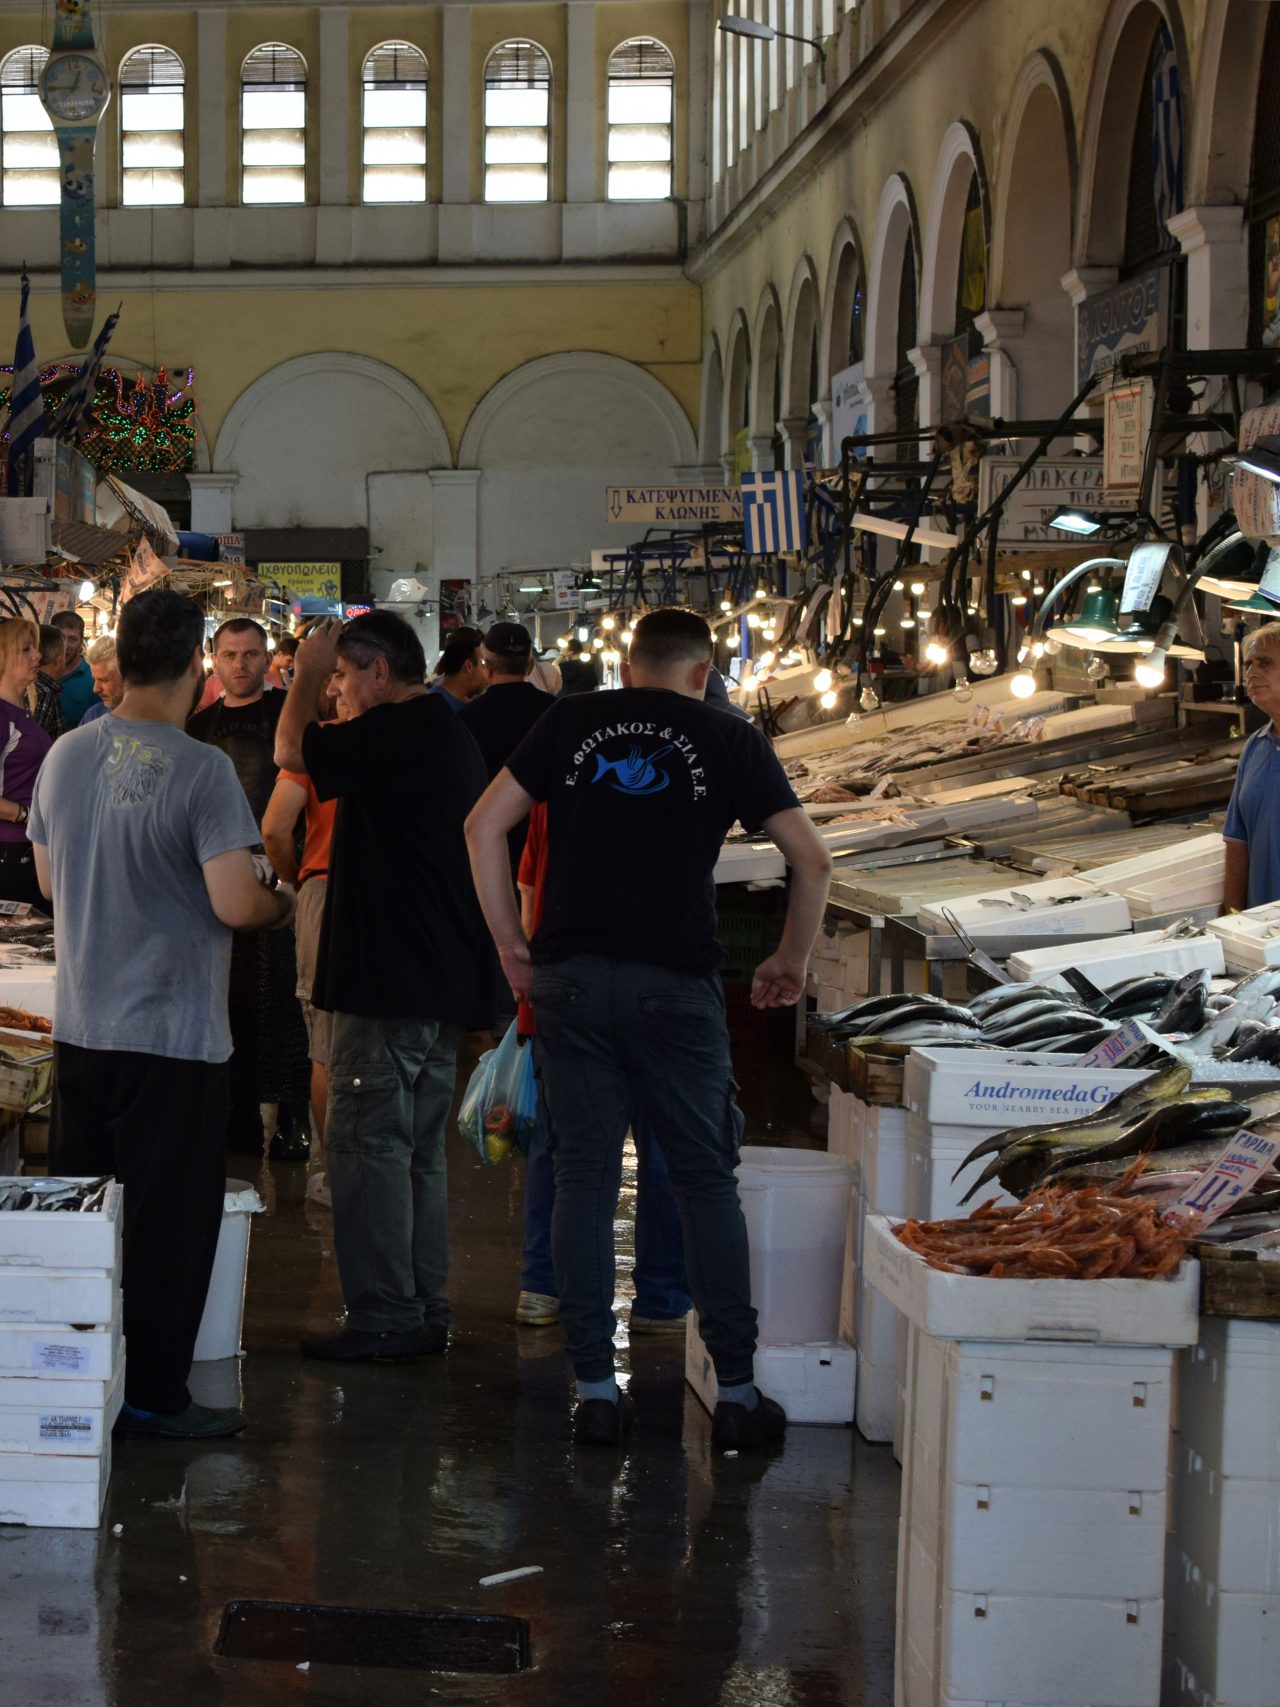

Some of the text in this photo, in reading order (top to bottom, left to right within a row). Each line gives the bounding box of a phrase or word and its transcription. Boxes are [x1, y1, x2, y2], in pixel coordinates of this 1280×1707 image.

[626, 489, 742, 504] ΚΑΤΕΨΥΓΜΕΝΑ
[655, 506, 720, 521] ΚΛΩΝΗΣ
[260, 564, 339, 577] ΙΧΘΥΟΠΩΛΕΙΟ
[573, 722, 657, 765] ΦΩΤΑΚΟΣ
[659, 727, 673, 740] &
[673, 735, 697, 764] ΣΙΑ
[969, 1103, 999, 1112] YOUR
[1003, 1104, 1045, 1113] NEARBY
[1049, 1106, 1070, 1114] SEA
[1234, 1132, 1275, 1156] ΓΑΡΙΔΑ
